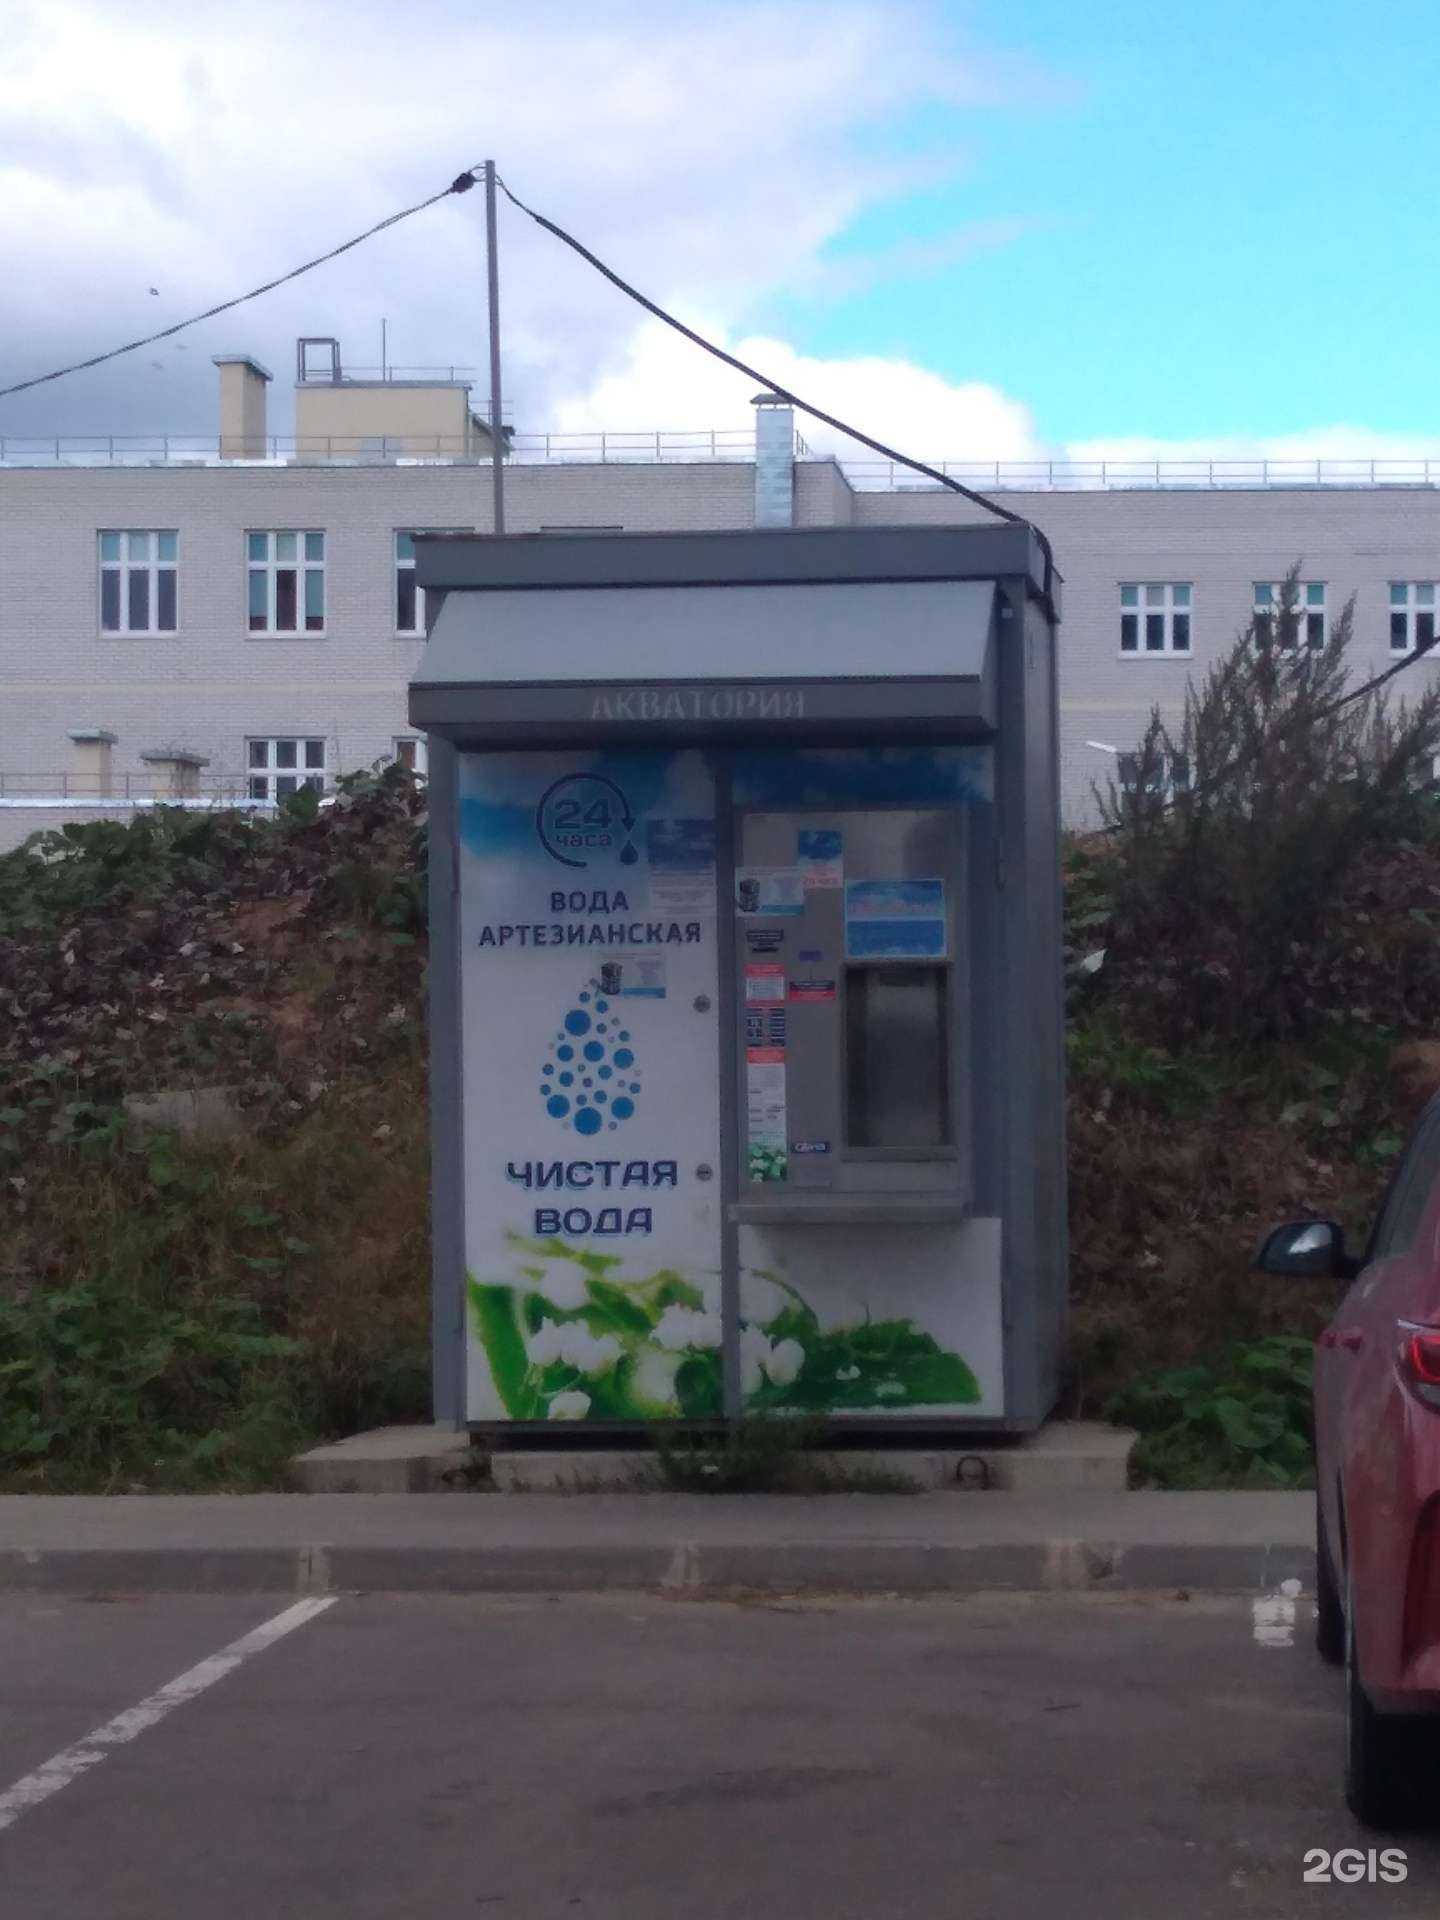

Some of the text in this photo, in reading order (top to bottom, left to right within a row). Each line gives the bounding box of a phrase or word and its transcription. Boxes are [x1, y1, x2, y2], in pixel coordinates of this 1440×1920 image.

[591, 689, 805, 719] АКВАТОРИЯ
[554, 800, 613, 829] 24
[555, 833, 613, 847] часа
[550, 890, 629, 914] ВОДА
[478, 922, 702, 947] АРТЕЗИАНСКАЯ
[506, 1160, 678, 1188] ЧИСТАЯ
[534, 1206, 653, 1235] ВОДА
